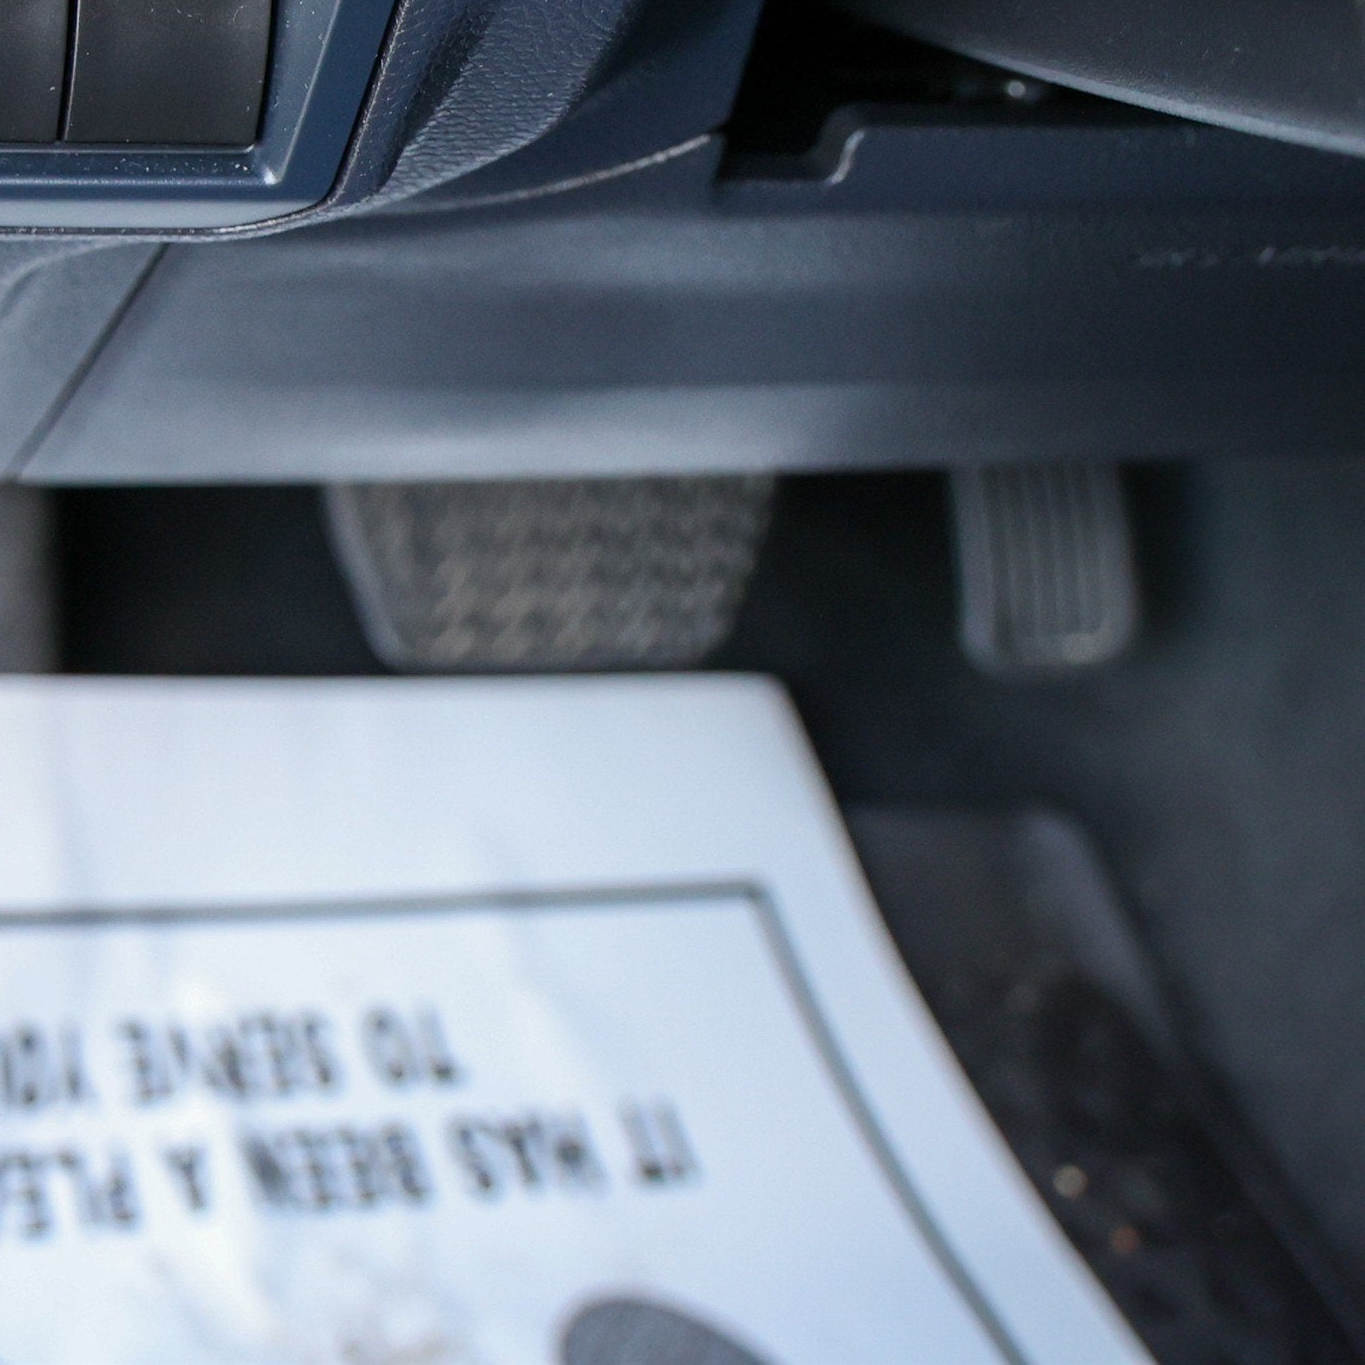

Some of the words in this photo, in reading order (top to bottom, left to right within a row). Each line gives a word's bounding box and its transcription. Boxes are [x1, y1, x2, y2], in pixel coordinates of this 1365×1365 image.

[117, 1007, 344, 1107] SERVE
[362, 1001, 465, 1092] TO
[165, 1142, 209, 1213] A
[237, 1119, 435, 1211] BEEN
[446, 1109, 607, 1197] HAS
[619, 1097, 700, 1187] IT
